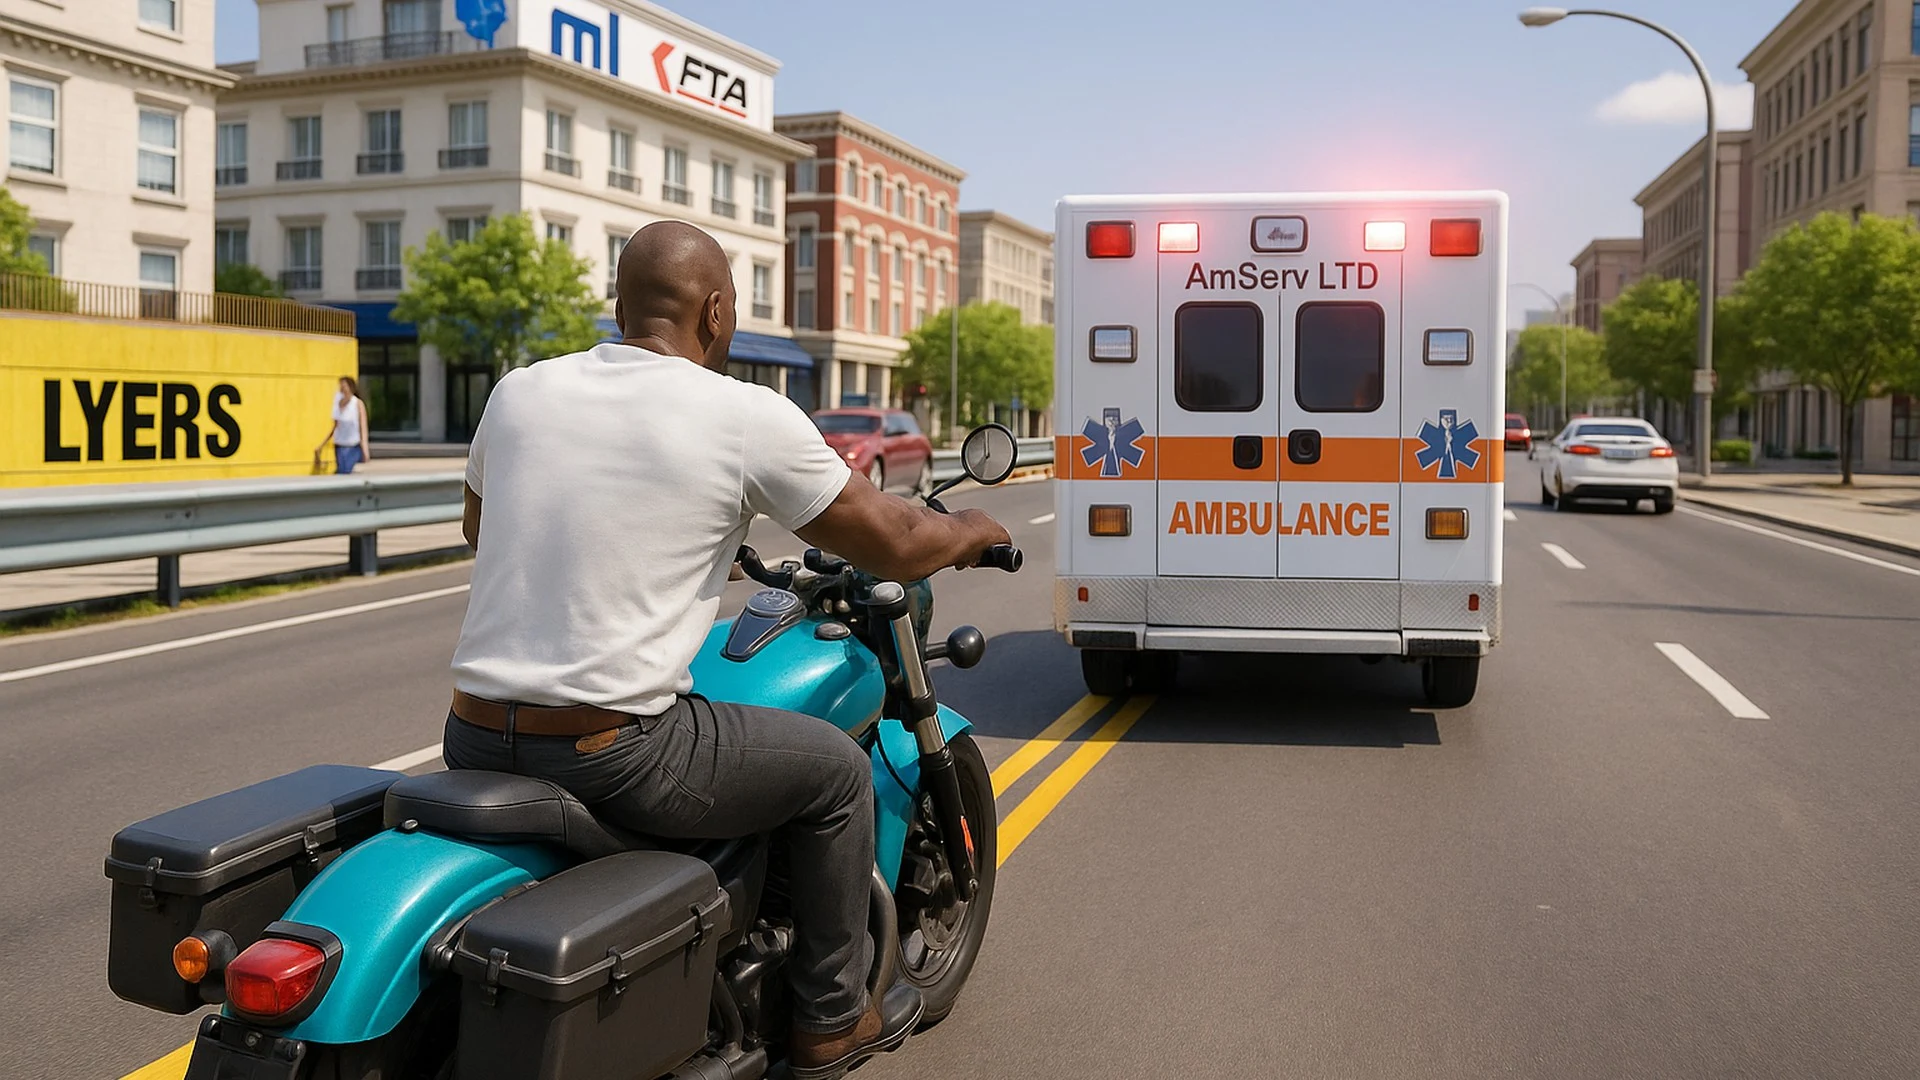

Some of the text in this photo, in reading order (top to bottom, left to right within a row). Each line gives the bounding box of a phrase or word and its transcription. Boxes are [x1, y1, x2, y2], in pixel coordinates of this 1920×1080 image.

[679, 54, 747, 109] FTA
[1185, 262, 1378, 290] AmServ LTD
[44, 379, 242, 463] LYERS
[1168, 501, 1390, 537] AMBULANCE
